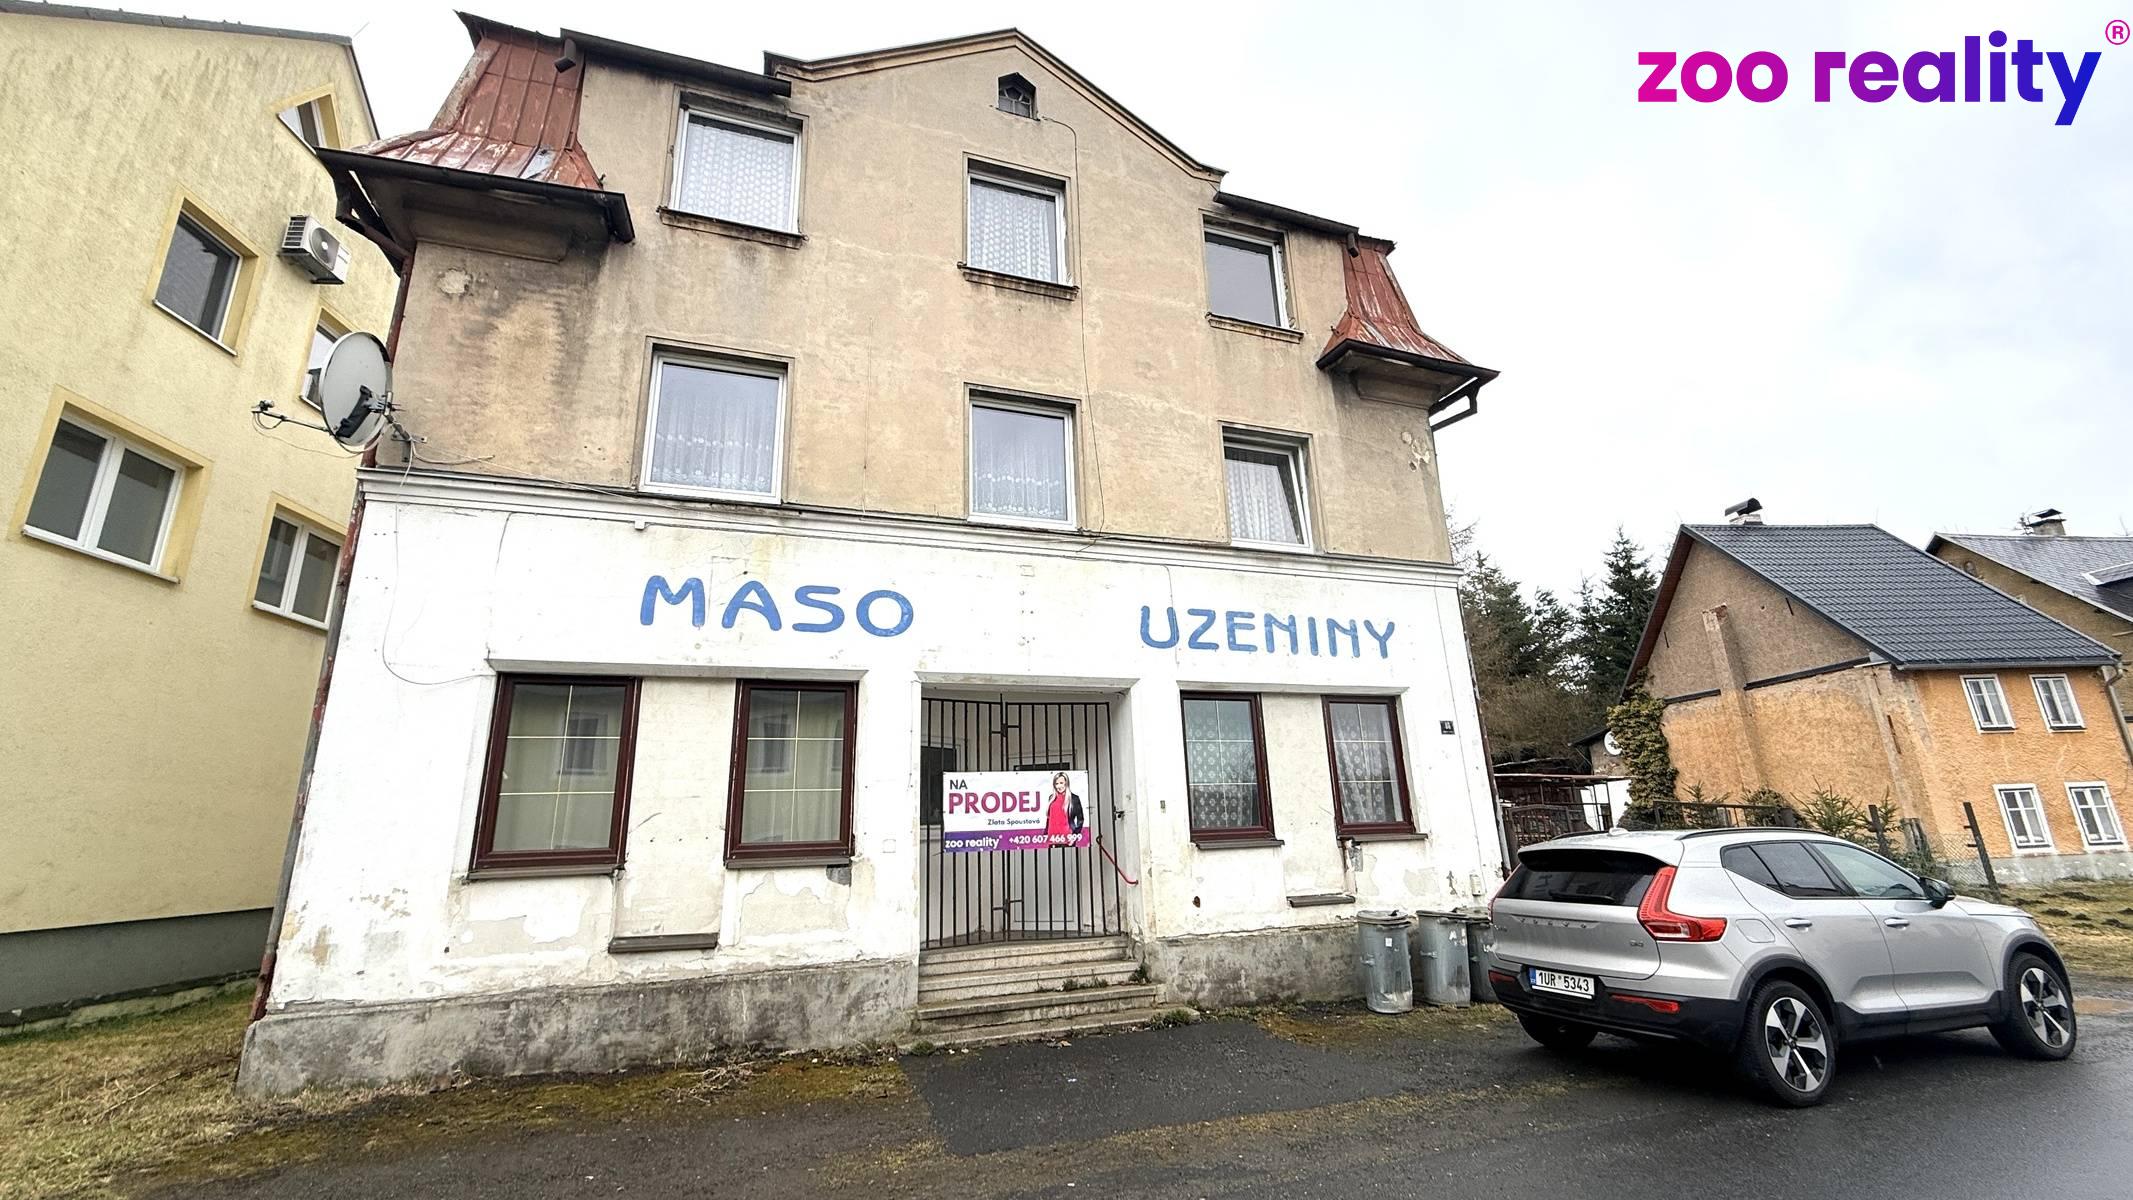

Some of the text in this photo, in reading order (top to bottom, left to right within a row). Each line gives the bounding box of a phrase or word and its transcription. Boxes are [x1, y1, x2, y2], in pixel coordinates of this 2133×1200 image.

[640, 575, 914, 637] MASO
[1140, 605, 1396, 659] UZENINY
[949, 779, 968, 790] NA
[949, 791, 1041, 814] PRODEJ
[945, 840, 964, 849] zoo
[1009, 835, 1031, 845] +420
[1032, 834, 1049, 844] 607
[1050, 834, 1066, 843] 466
[1538, 971, 1590, 992] 1UR 5343
